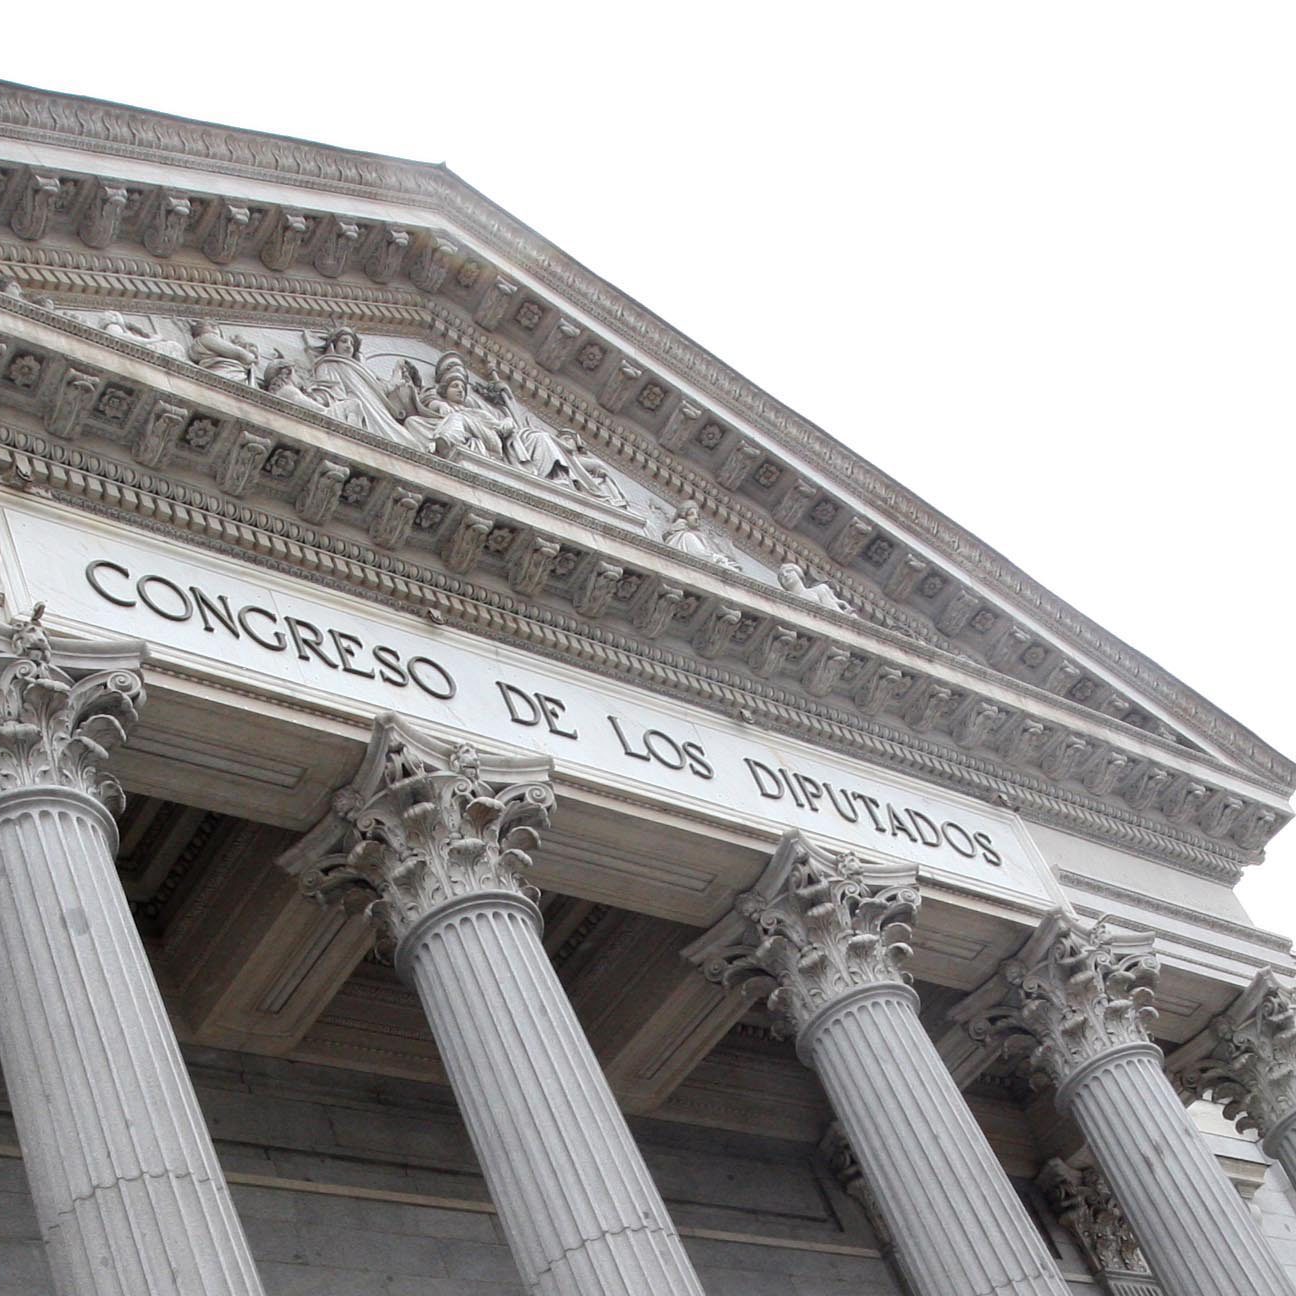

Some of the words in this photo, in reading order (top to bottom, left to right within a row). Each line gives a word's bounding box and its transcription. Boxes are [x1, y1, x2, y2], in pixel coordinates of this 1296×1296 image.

[85, 559, 456, 699] CONGRESO
[496, 681, 577, 739] DE
[608, 715, 714, 779] LOS
[744, 758, 1002, 866] DIPUTADOS
